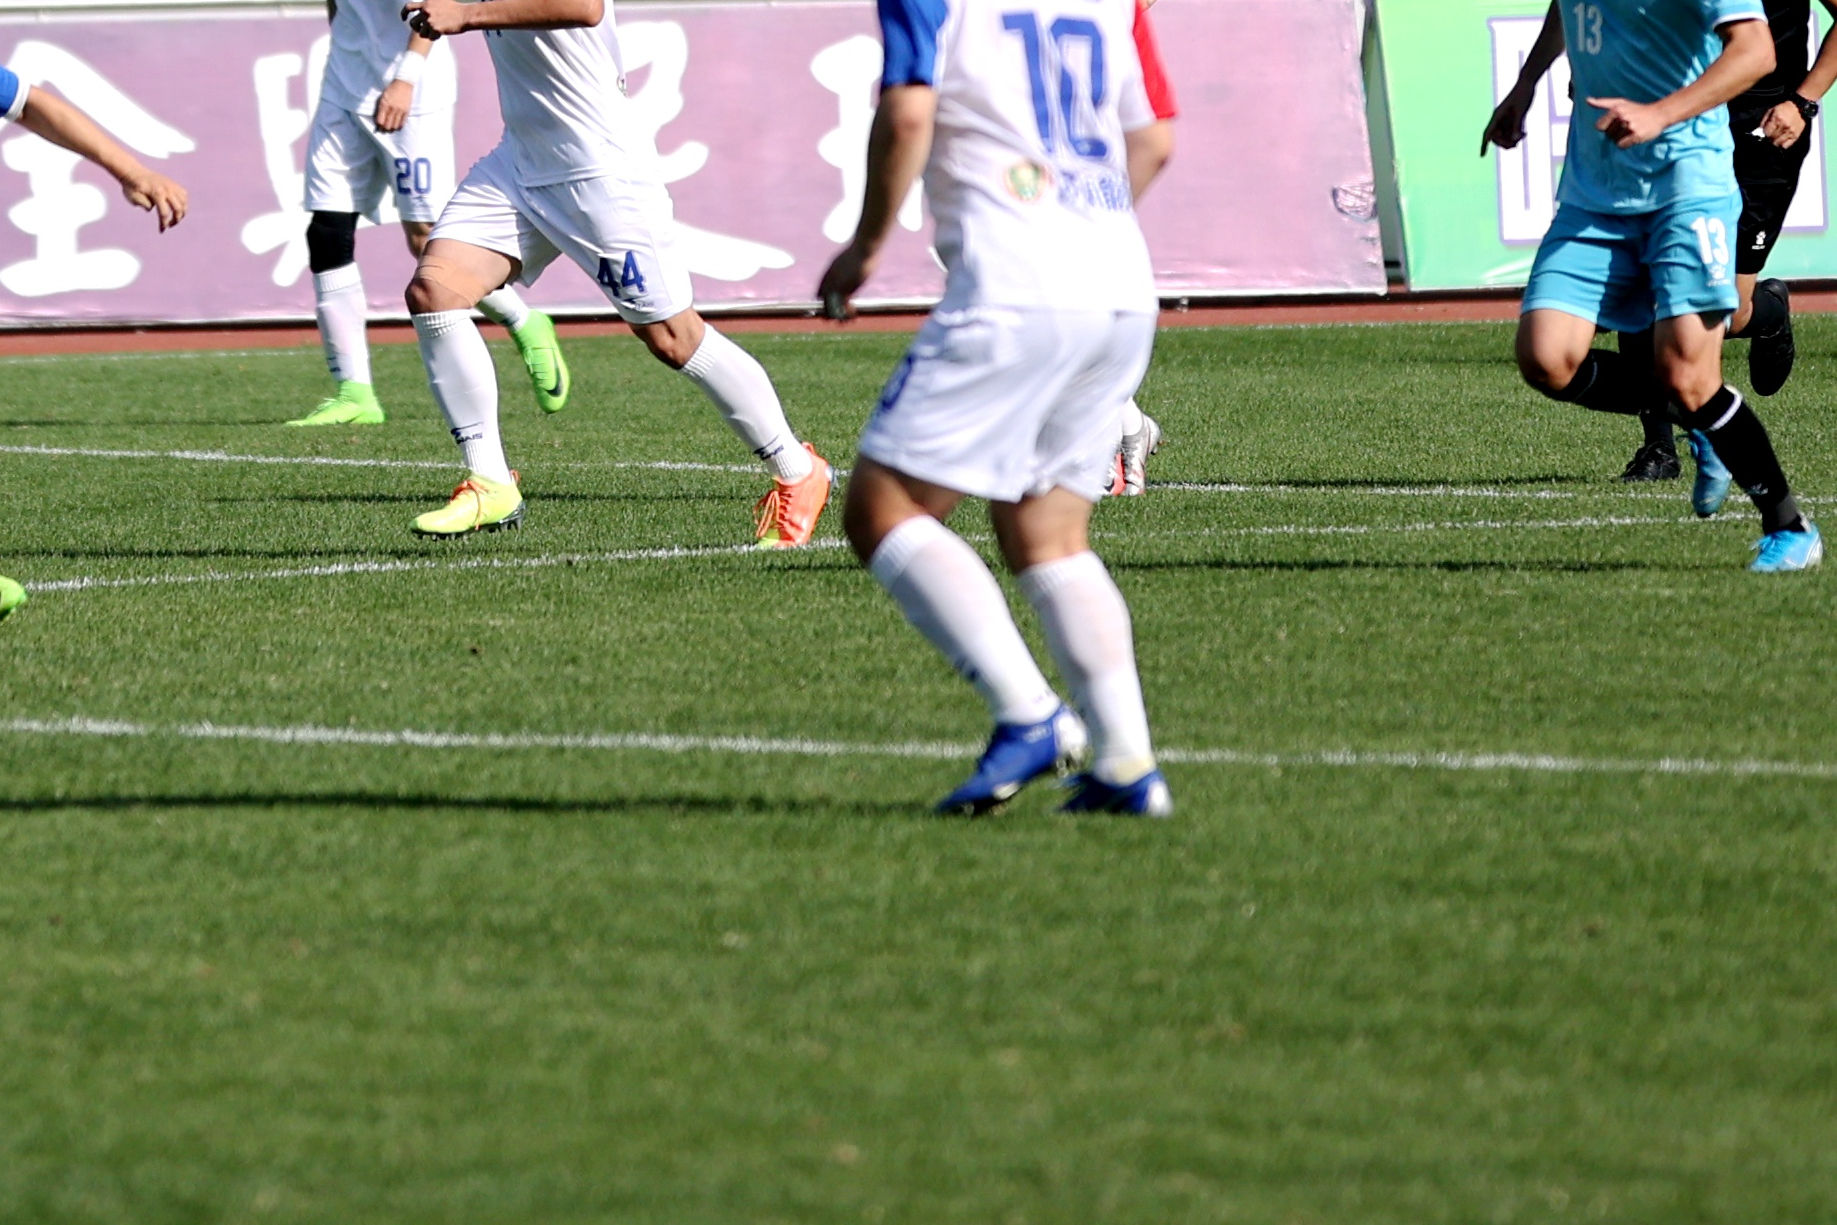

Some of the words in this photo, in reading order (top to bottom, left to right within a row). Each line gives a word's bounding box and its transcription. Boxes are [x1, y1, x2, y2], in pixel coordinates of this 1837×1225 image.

[1573, 2, 1604, 56] 13
[1001, 12, 1108, 157] 10
[394, 157, 432, 196] 20
[1691, 216, 1729, 266] 13
[597, 250, 645, 298] 44
